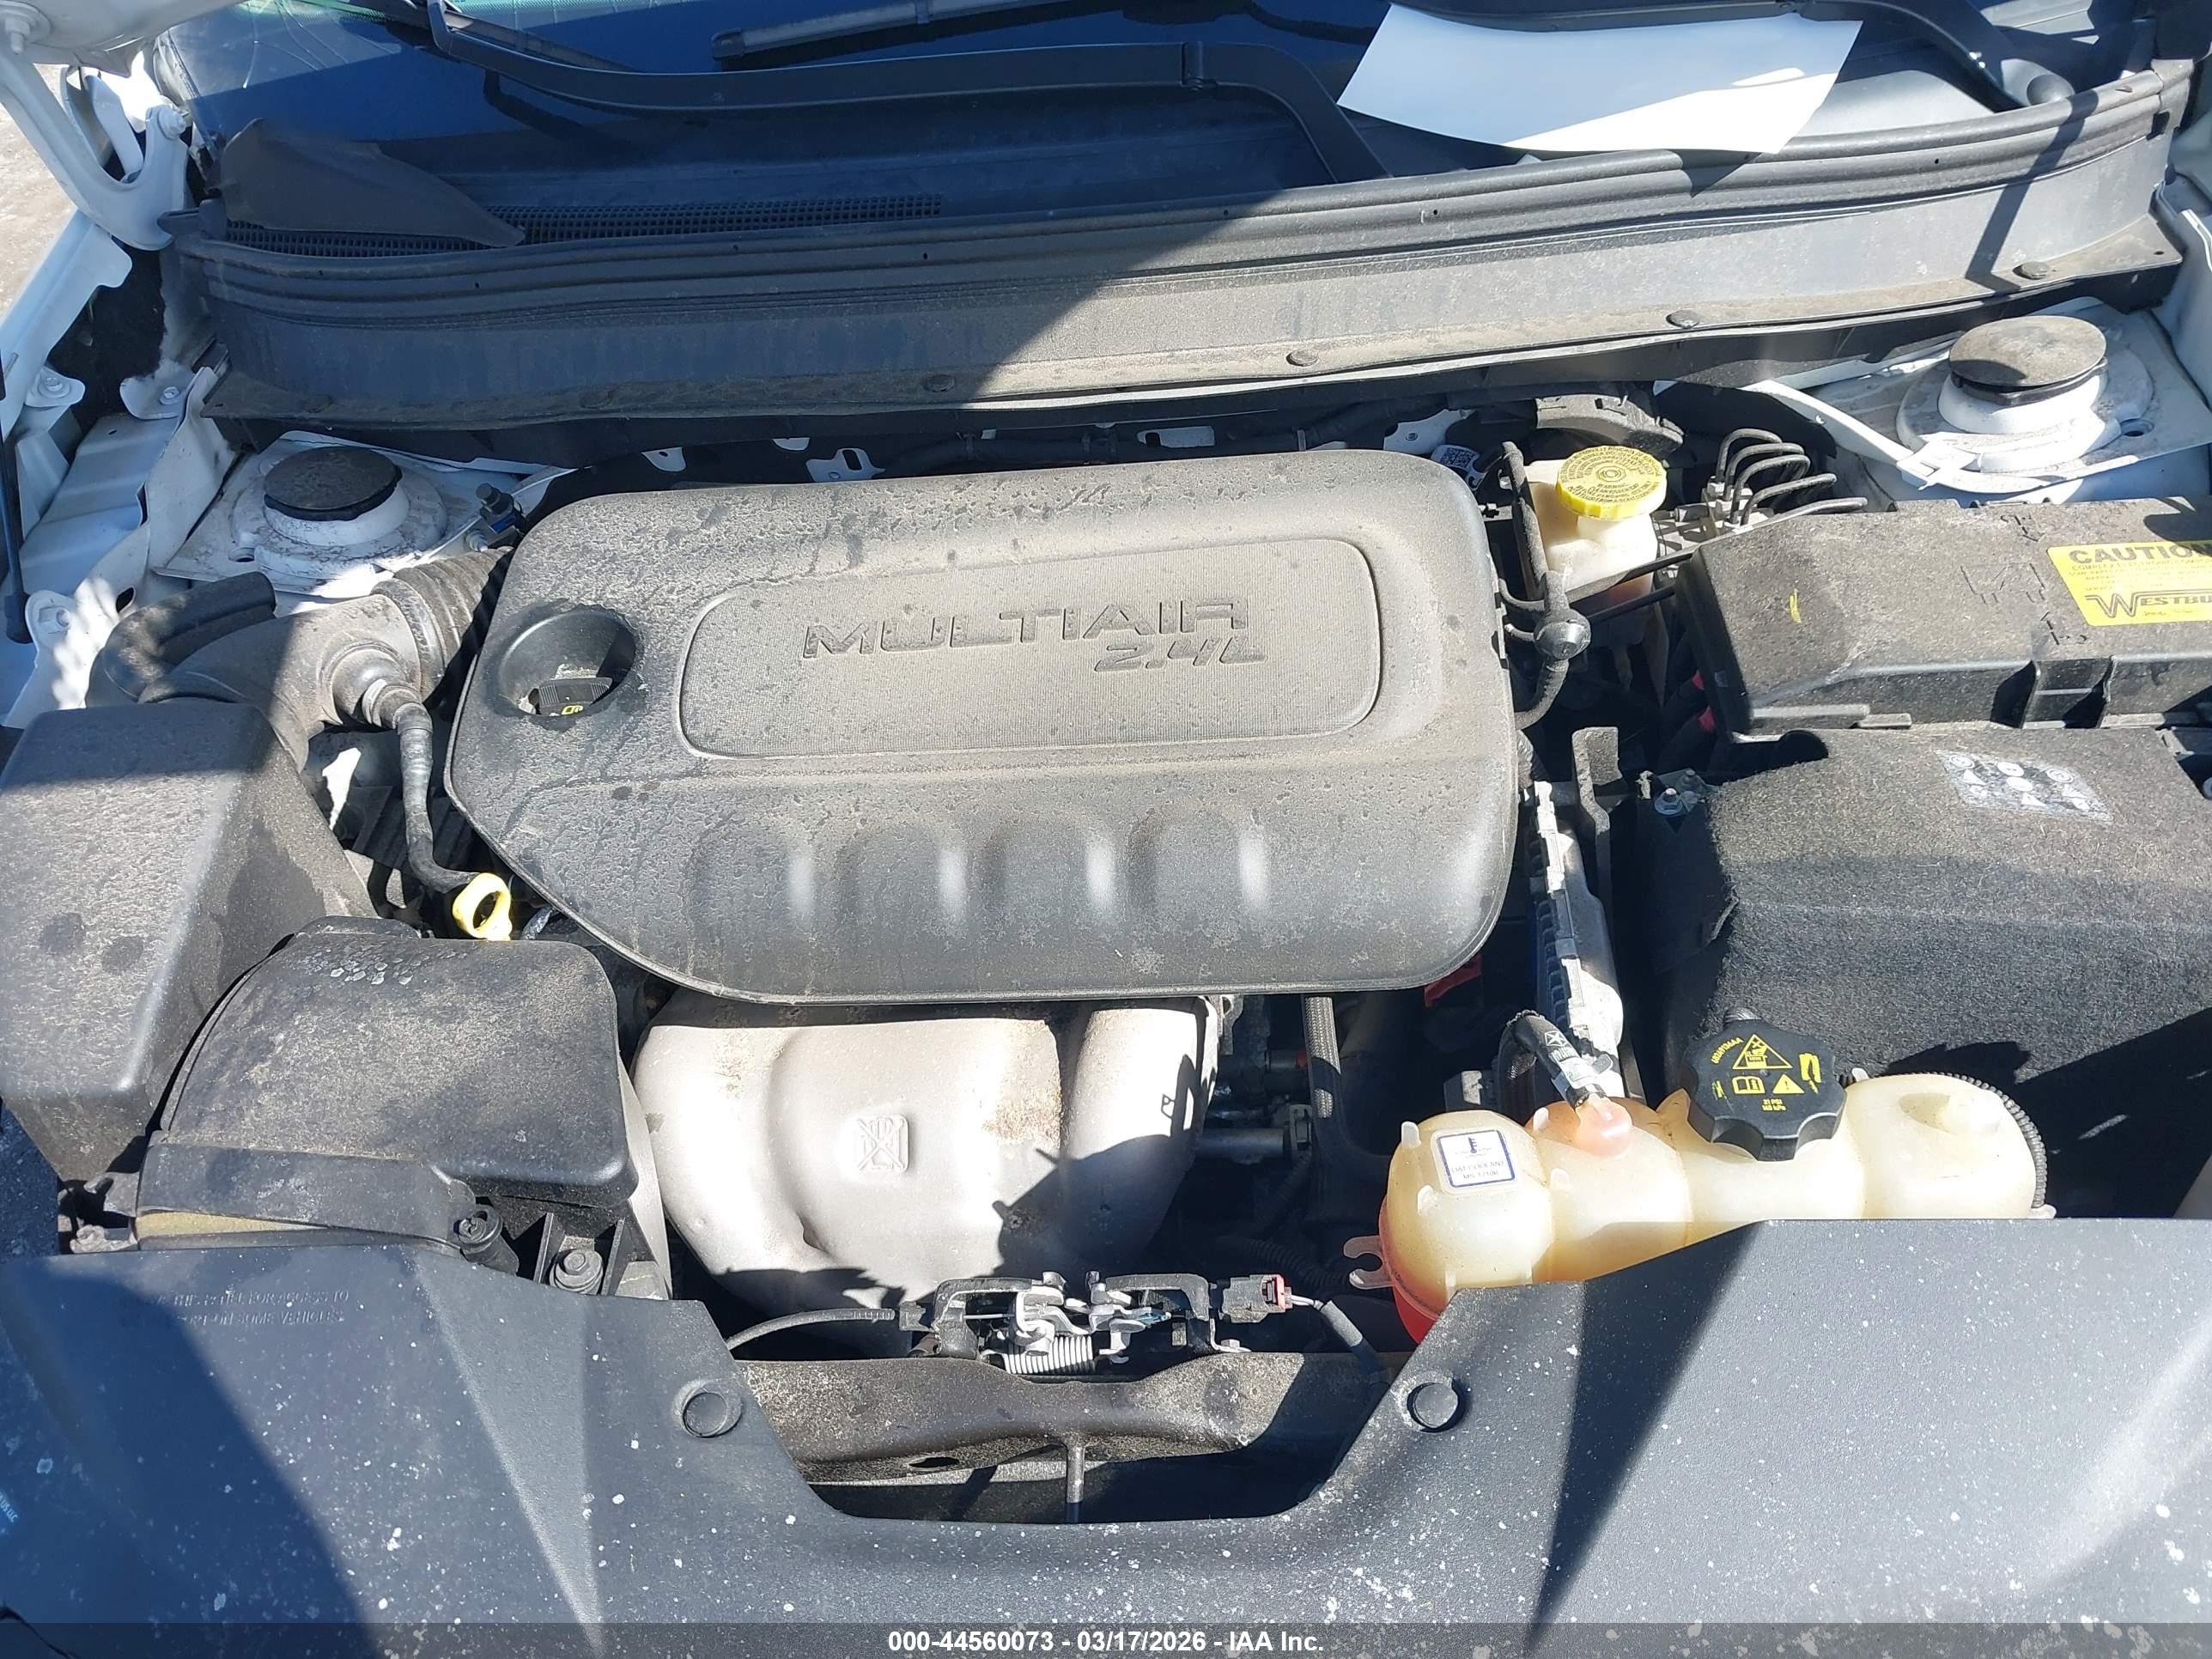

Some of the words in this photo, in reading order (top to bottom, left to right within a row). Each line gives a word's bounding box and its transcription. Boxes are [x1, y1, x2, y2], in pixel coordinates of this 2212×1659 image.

[2069, 544, 2212, 563] CAUTION
[802, 597, 1249, 659] MULTIAIR
[1093, 635, 1268, 672] 2.4L
